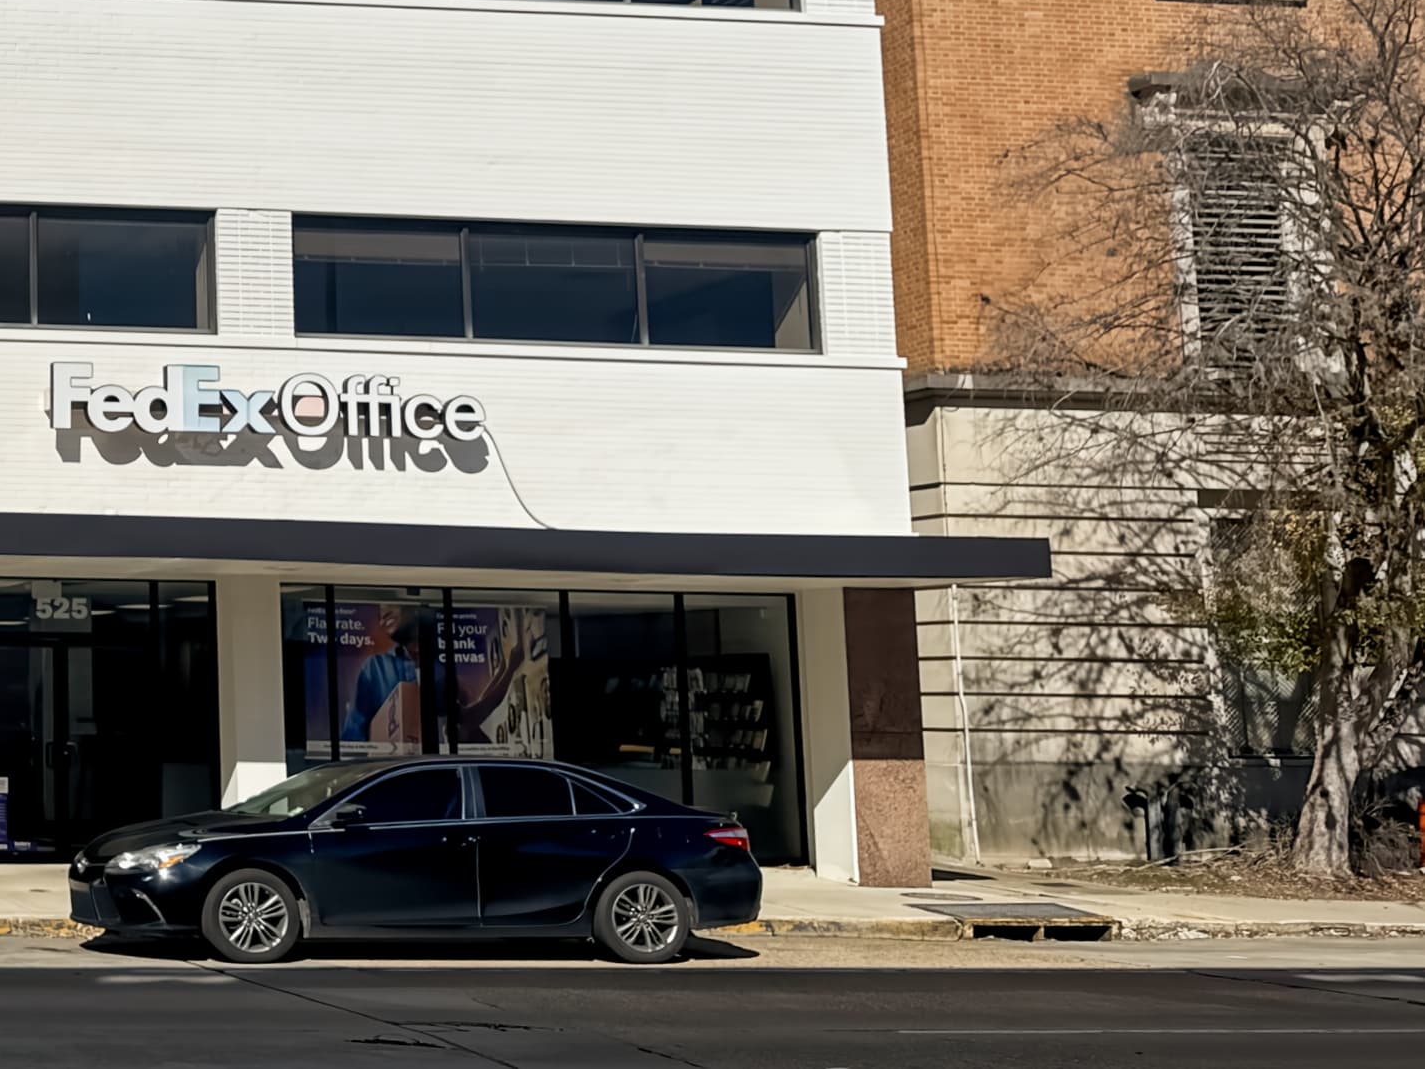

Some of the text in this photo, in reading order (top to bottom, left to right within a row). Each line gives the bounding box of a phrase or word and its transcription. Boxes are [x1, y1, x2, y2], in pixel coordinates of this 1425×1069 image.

[49, 361, 487, 442] FedEx Office
[35, 597, 89, 620] 525
[307, 616, 365, 630] Fla rate.
[437, 622, 487, 637] Fl your
[307, 632, 375, 649] Tw days.
[438, 637, 476, 650] bank
[438, 651, 485, 664] cnvas
